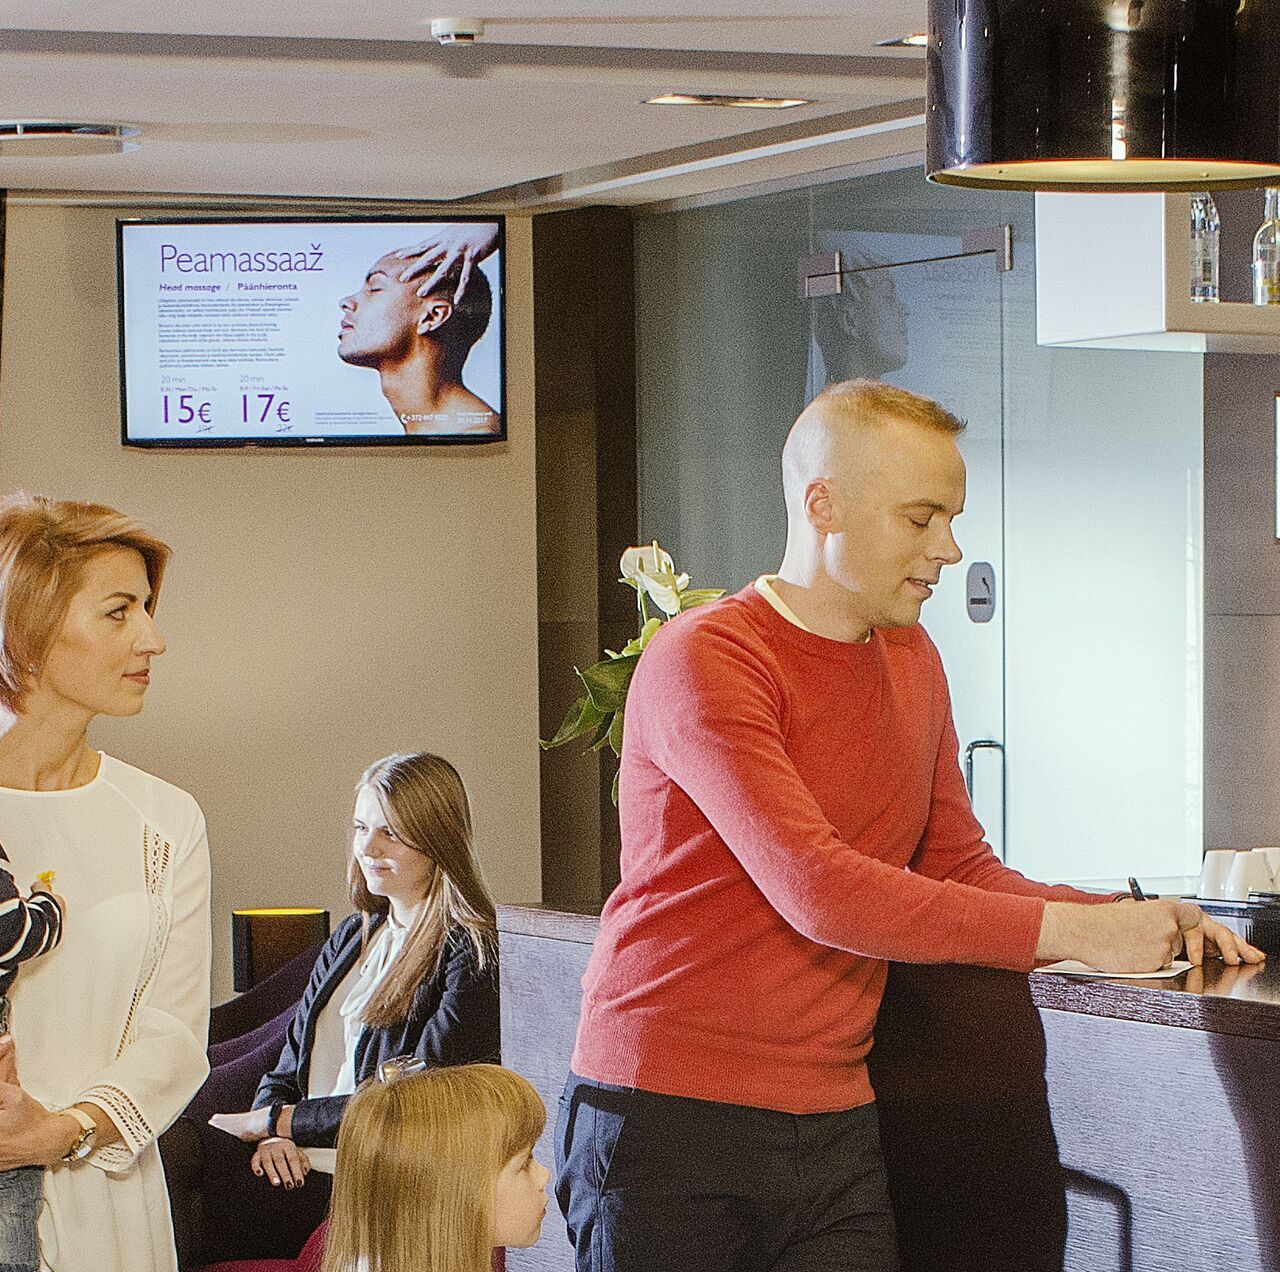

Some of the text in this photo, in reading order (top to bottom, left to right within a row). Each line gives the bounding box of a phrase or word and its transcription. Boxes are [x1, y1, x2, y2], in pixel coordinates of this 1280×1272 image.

[160, 243, 324, 273] Peamassaaž
[158, 283, 183, 292] Head
[184, 284, 222, 293] massage
[237, 282, 298, 292] Päänhieronta
[163, 395, 212, 424] 15€
[242, 394, 290, 423] 17€
